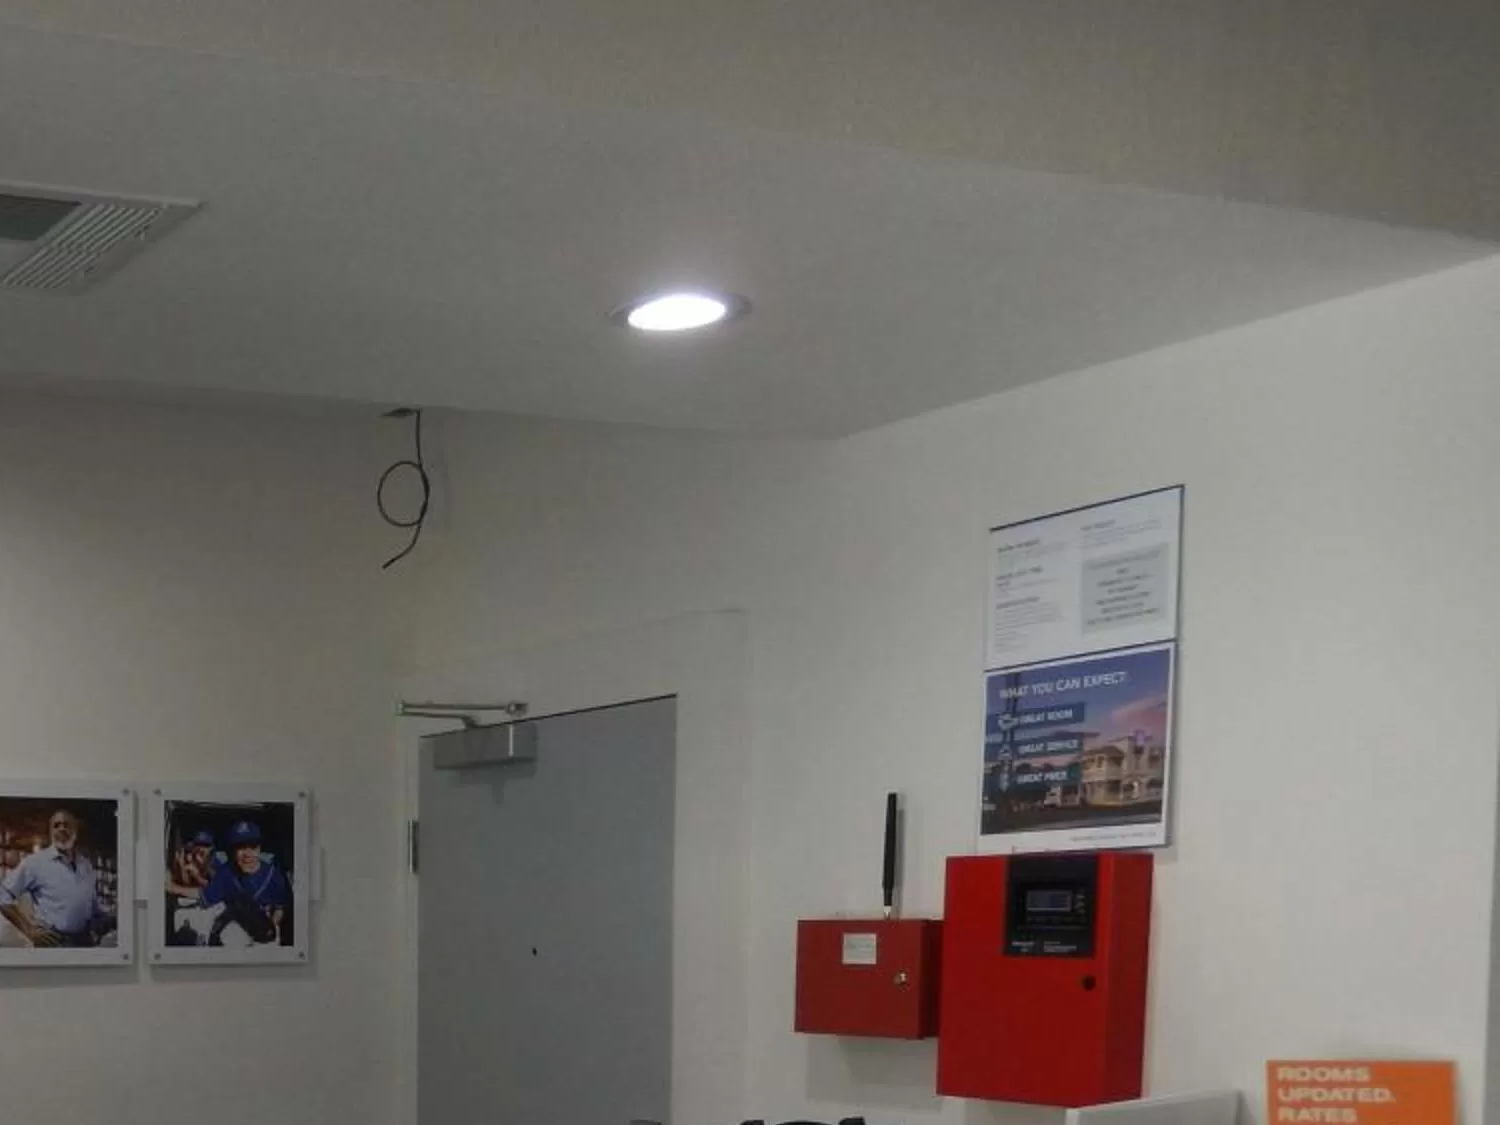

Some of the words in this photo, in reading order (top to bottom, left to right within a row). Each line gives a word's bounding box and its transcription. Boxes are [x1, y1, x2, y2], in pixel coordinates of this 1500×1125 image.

[1000, 685, 1028, 698] WHAT
[1032, 682, 1053, 695] YOU
[1056, 677, 1081, 691] CAN
[1277, 1107, 1358, 1122] RATES
